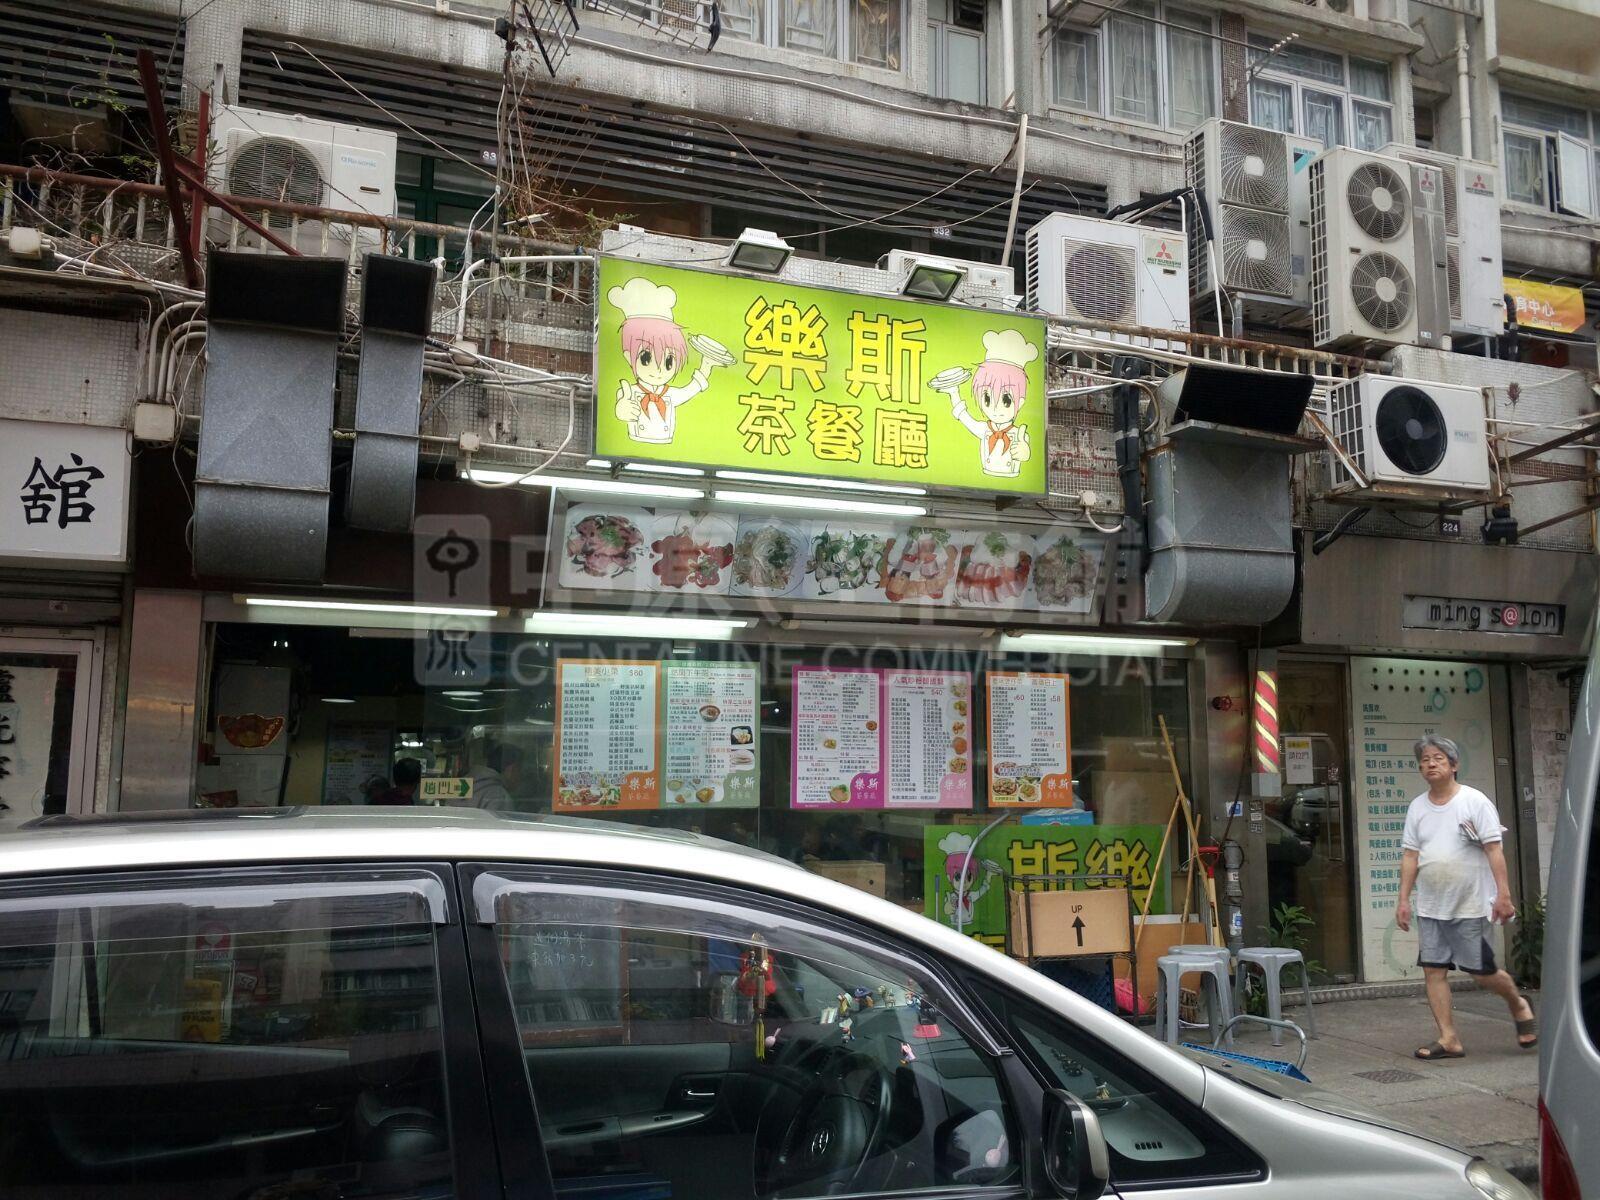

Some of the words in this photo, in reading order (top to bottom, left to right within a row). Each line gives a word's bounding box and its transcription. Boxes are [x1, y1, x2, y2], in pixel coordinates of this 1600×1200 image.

[744, 295, 927, 404] 樂斯
[737, 391, 929, 469] 茶餐廳
[1442, 522, 1459, 532] 224
[1429, 602, 1481, 629] ming
[1071, 904, 1083, 914] UP
